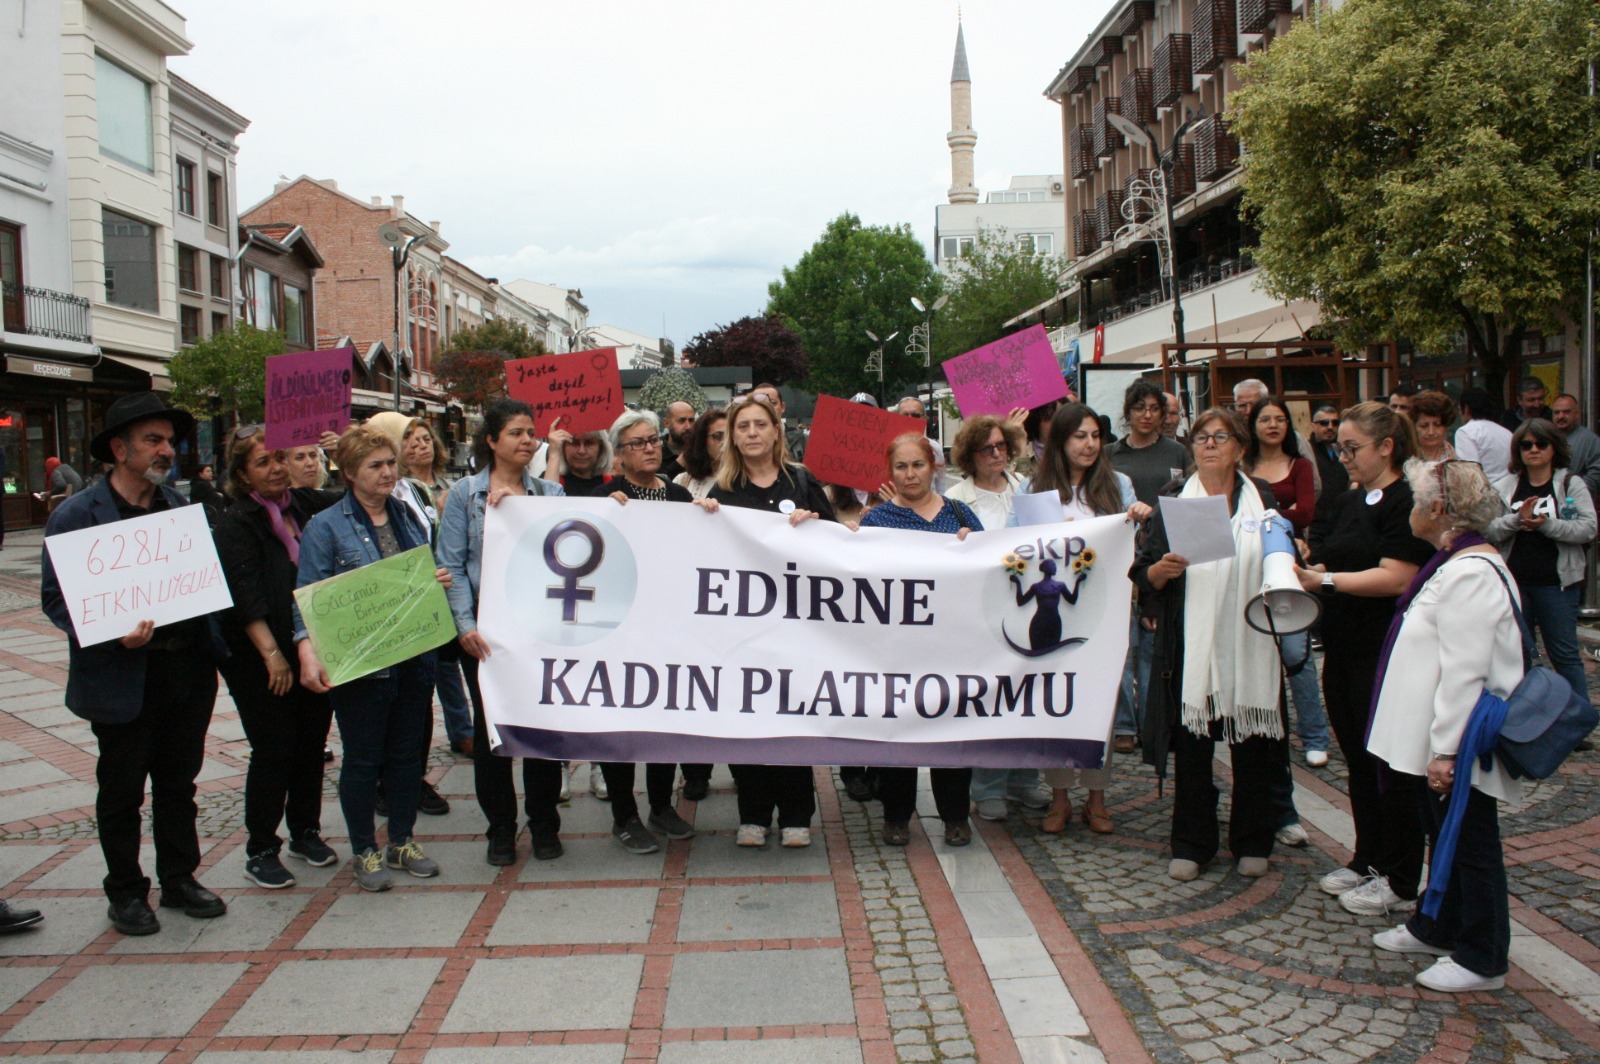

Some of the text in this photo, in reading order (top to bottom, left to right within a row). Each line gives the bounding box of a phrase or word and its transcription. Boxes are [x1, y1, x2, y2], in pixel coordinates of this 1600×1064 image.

[1014, 536, 1086, 567] ekp
[158, 562, 223, 603] UYGULA
[695, 562, 935, 626] EDİRNE
[539, 657, 1077, 718] KADIN PLATFORMU
